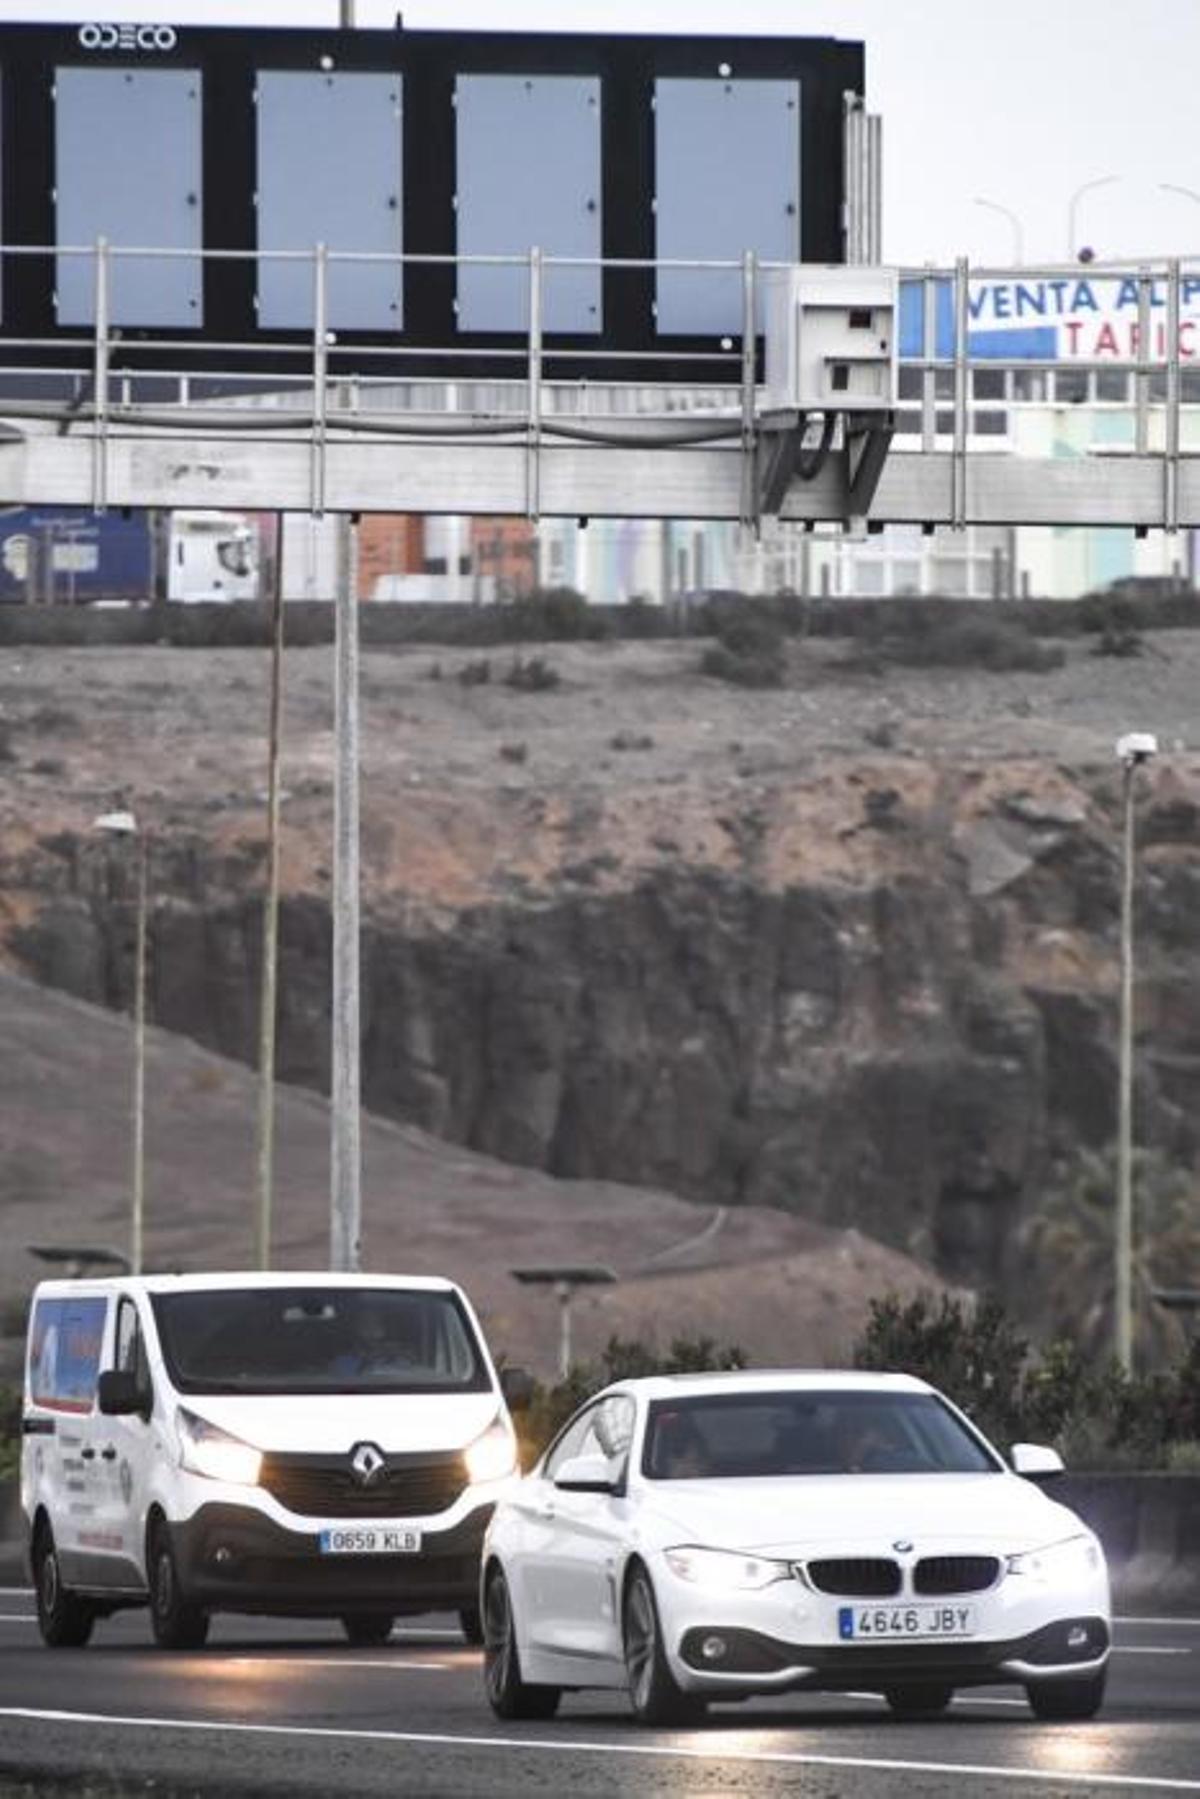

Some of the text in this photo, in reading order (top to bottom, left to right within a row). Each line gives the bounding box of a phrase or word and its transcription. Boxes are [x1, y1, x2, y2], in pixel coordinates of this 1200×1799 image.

[967, 281, 1098, 319] VENTA
[1115, 276, 1166, 309] AL
[332, 1532, 416, 1550] 0659 KLB
[859, 1609, 970, 1632] 4646 JBY
